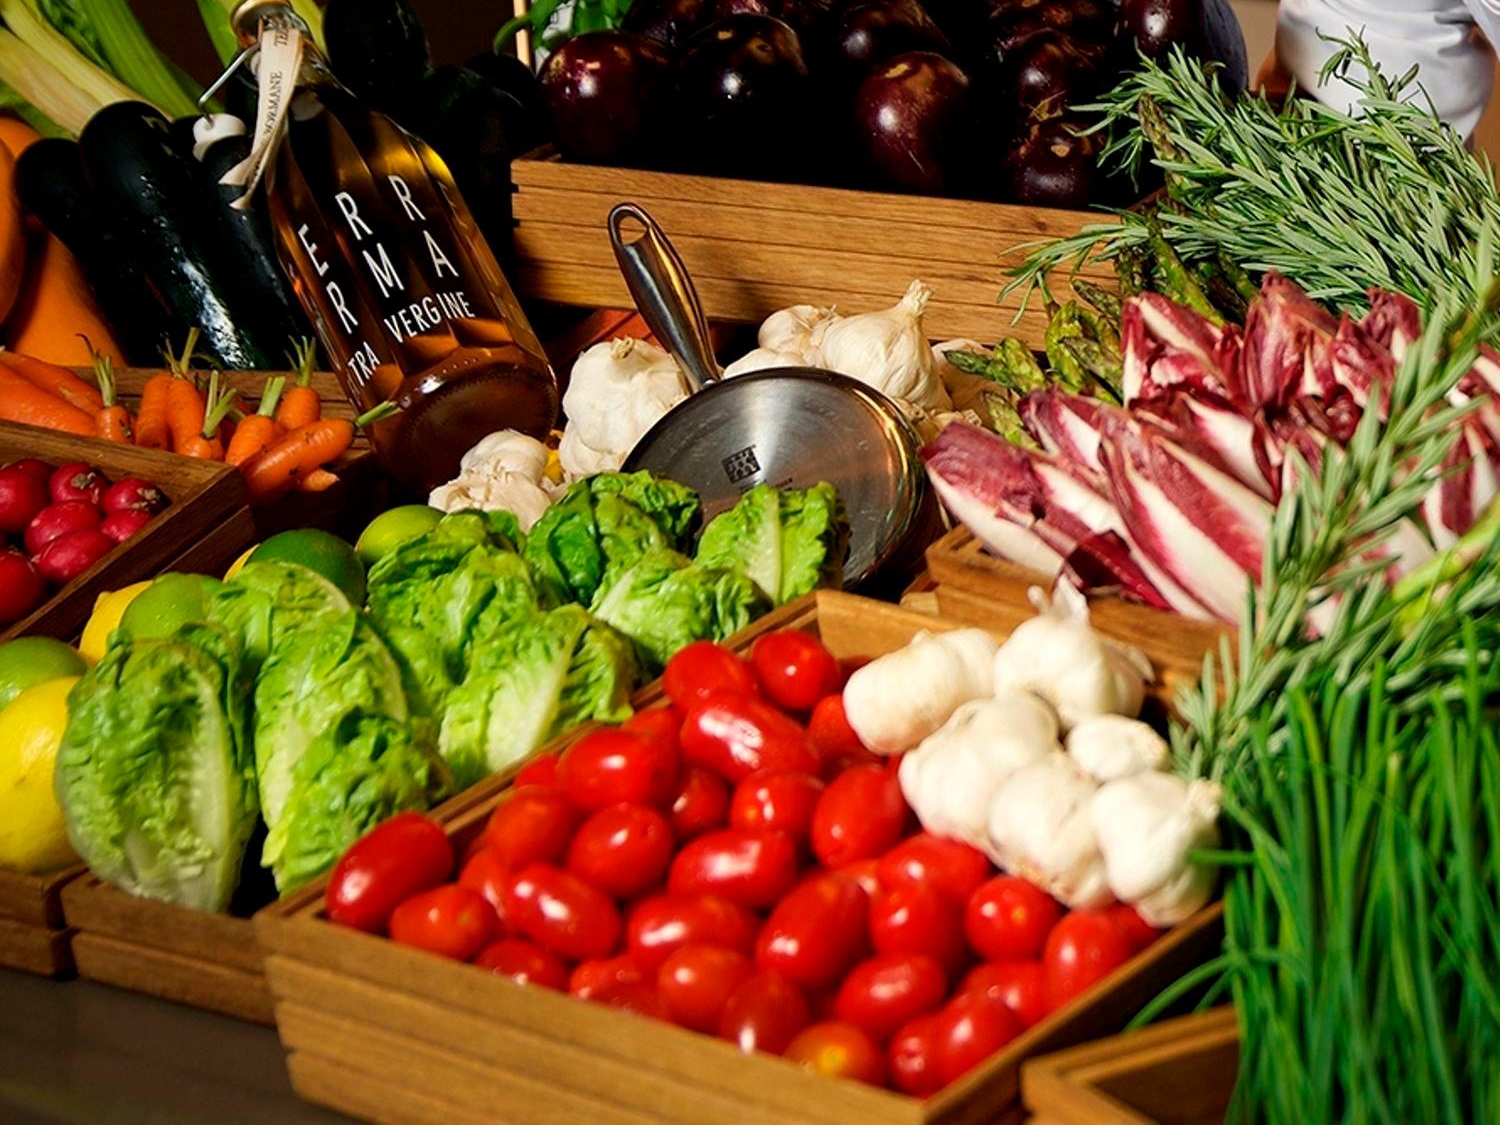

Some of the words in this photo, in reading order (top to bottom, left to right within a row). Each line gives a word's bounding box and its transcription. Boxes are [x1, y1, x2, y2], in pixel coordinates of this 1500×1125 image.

[298, 175, 427, 277] ERR
[347, 340, 382, 387] TRA
[383, 290, 477, 344] VERGINE
